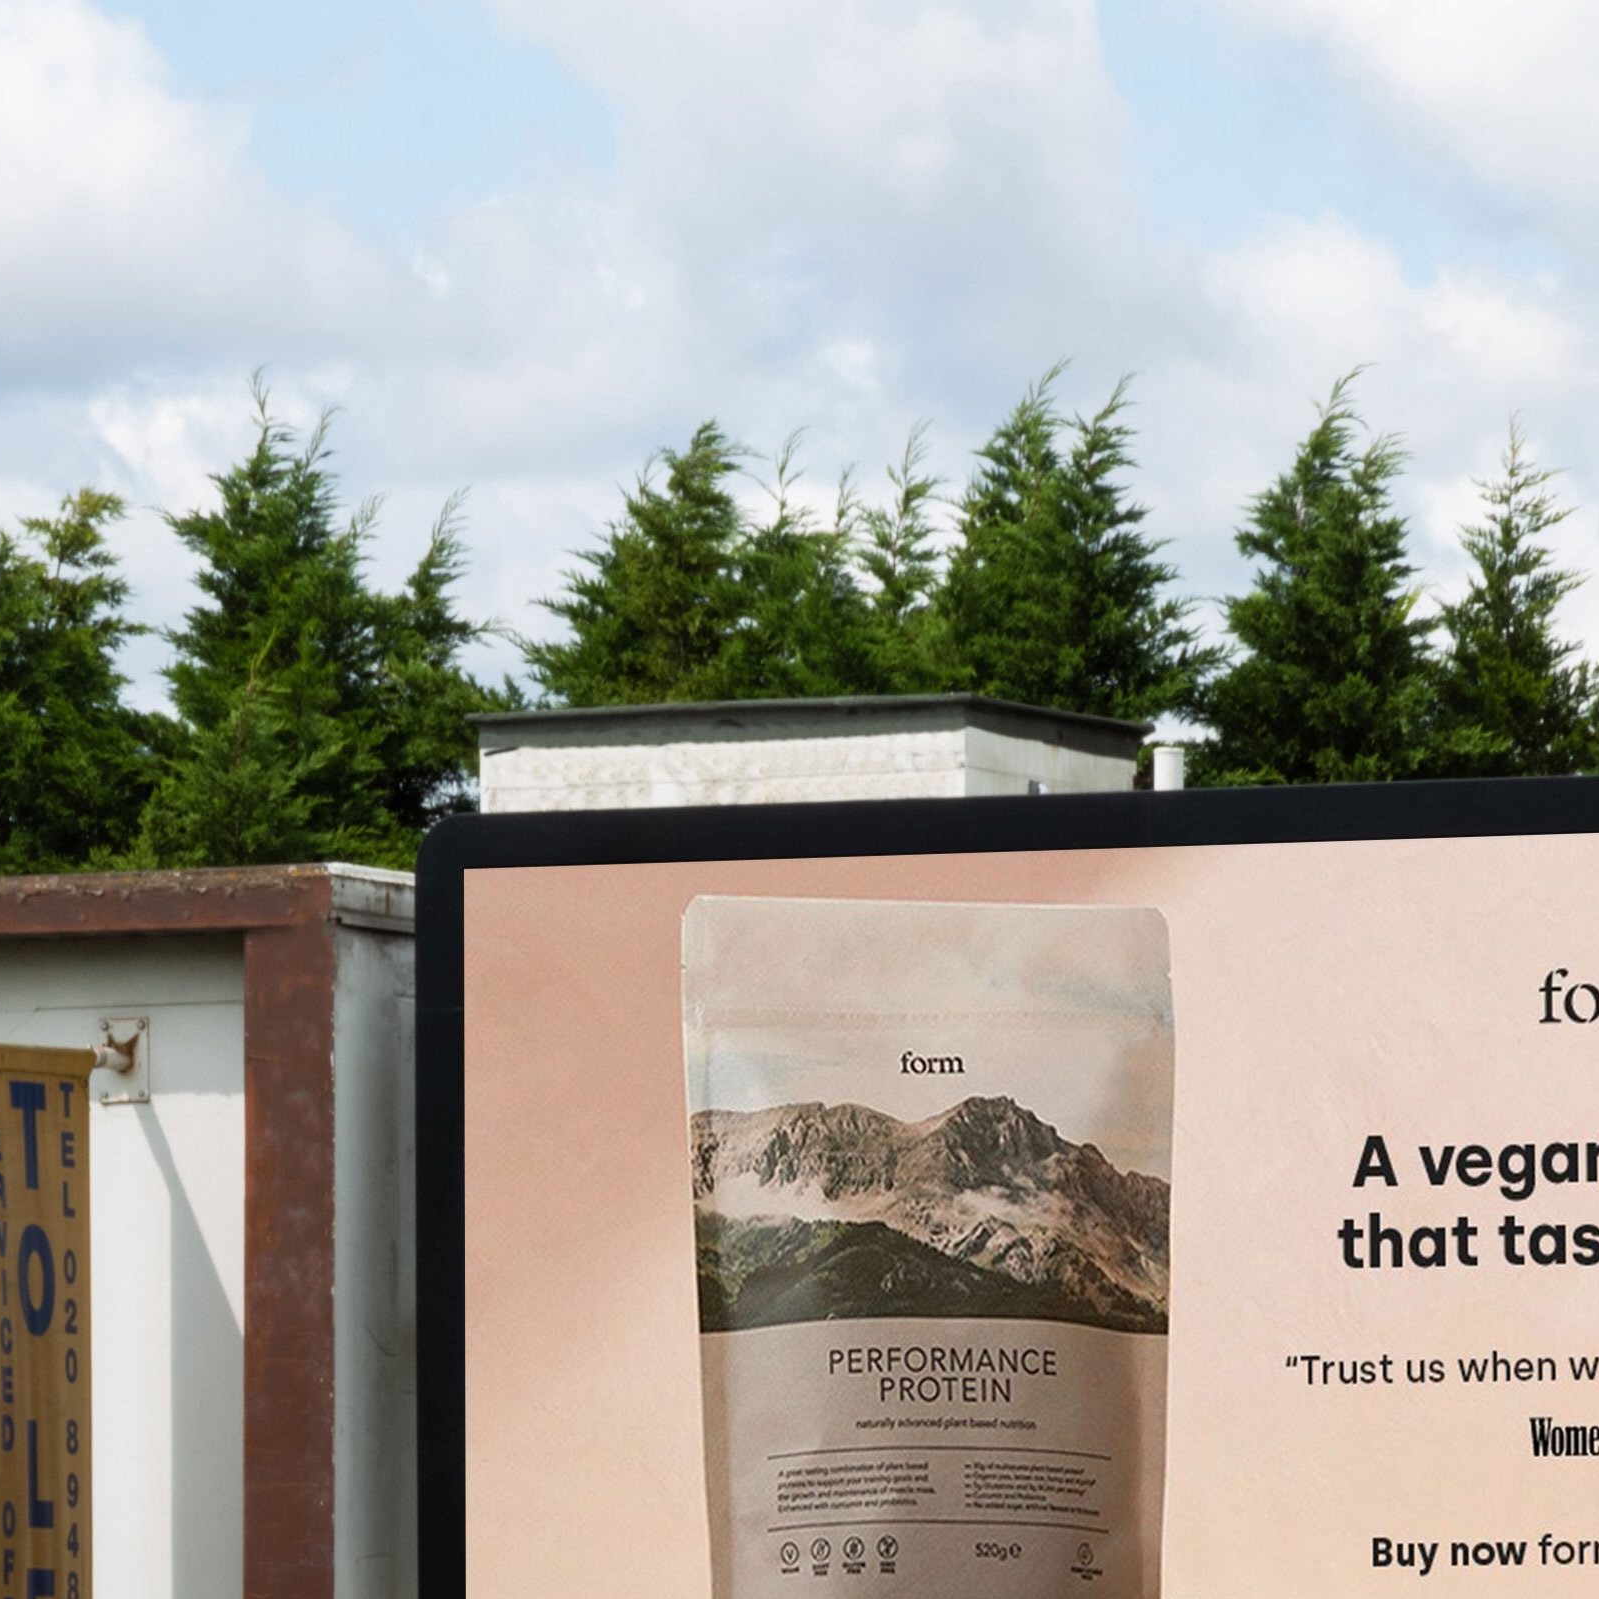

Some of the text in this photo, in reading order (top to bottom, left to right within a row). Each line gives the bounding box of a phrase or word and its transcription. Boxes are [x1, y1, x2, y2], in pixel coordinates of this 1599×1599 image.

[901, 1051, 965, 1075] form
[59, 1081, 75, 1217] TEL
[1353, 1135, 1399, 1188] A
[1338, 1213, 1479, 1269] that
[64, 1249, 77, 1383] 020
[829, 1347, 1058, 1377] PERFORMANCE
[1407, 1360, 1447, 1384] us
[1458, 1351, 1557, 1383] when
[879, 1376, 1012, 1403] PROTEIN
[1373, 1538, 1439, 1577] Buy
[1451, 1542, 1529, 1567] now
